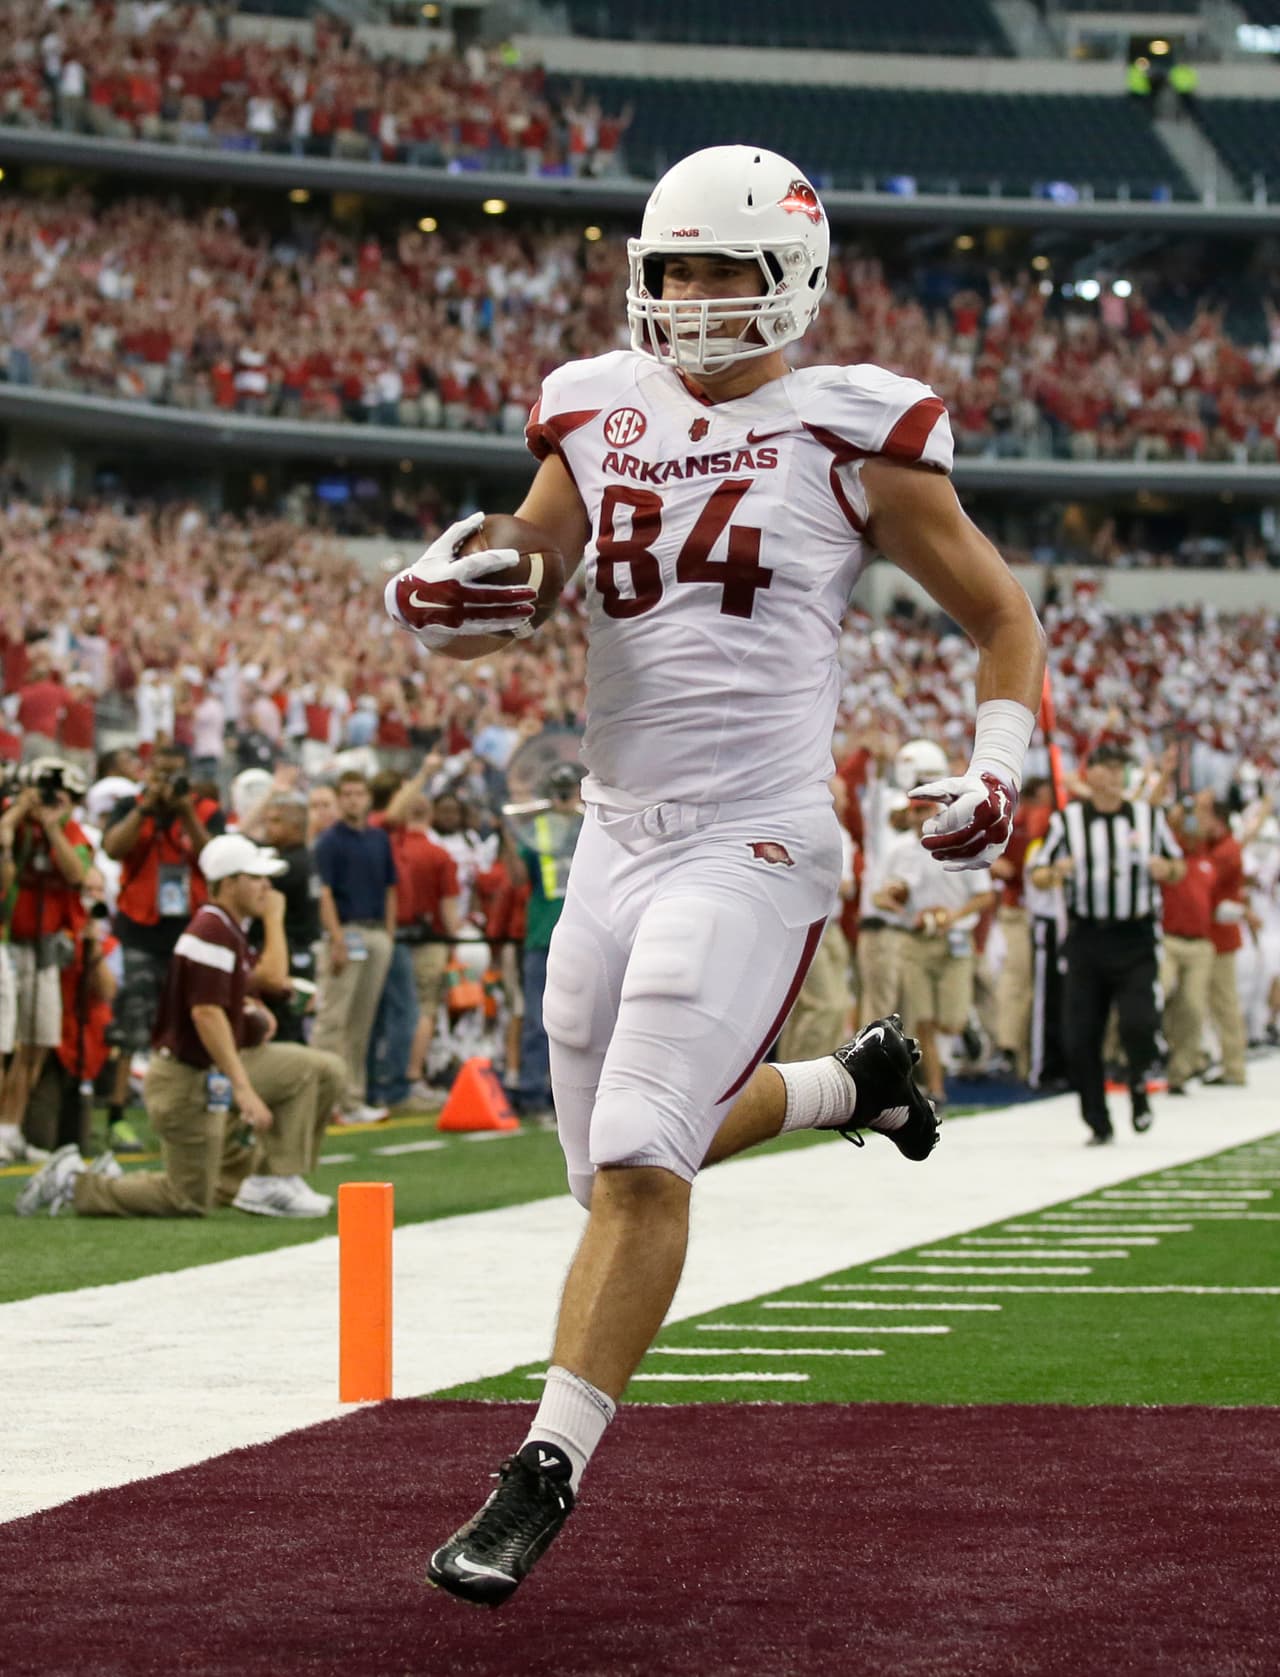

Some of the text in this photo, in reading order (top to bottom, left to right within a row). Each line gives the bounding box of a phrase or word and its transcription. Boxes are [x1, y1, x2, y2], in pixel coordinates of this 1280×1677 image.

[607, 410, 643, 444] SEC
[602, 448, 778, 484] ARKANSAS
[596, 479, 773, 619] 84
